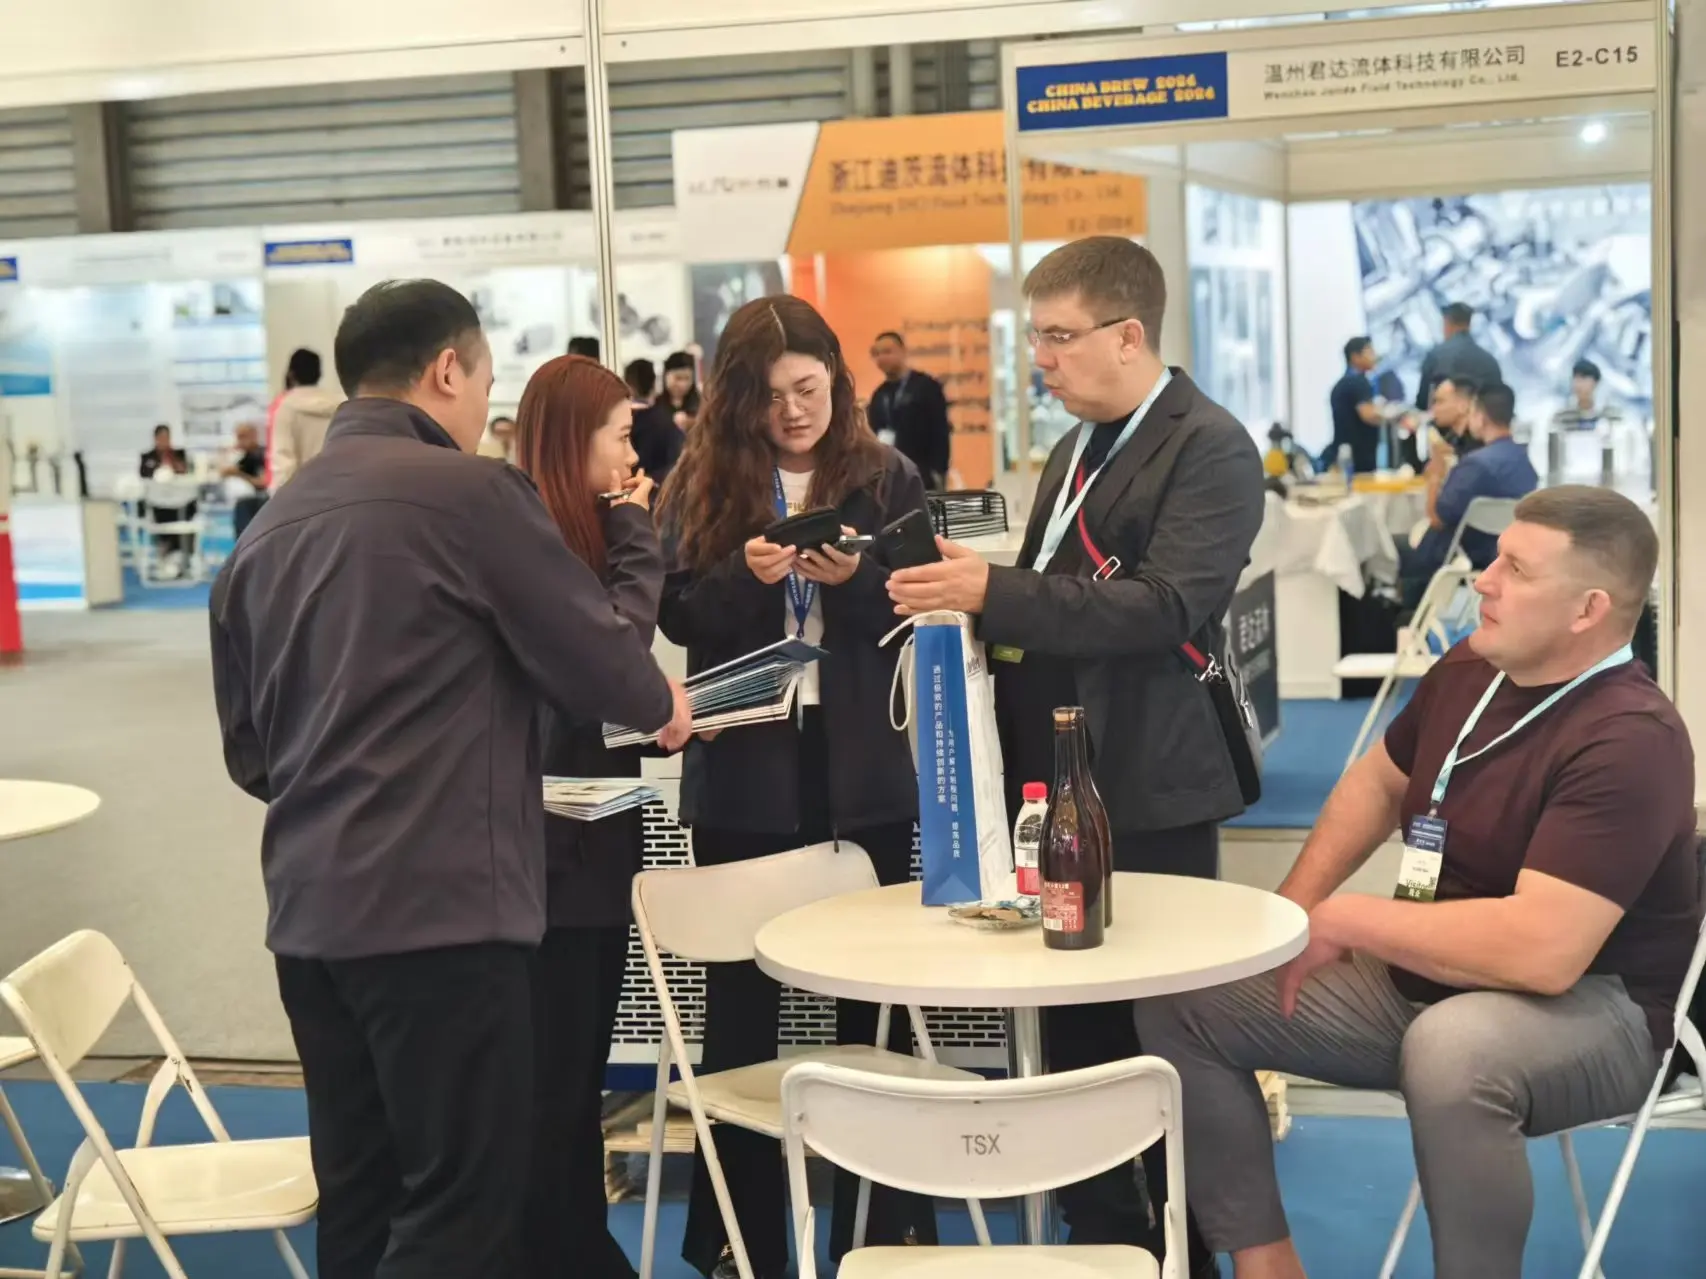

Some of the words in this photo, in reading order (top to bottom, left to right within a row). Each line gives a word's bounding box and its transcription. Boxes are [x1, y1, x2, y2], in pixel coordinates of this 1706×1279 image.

[1264, 44, 1526, 84] 温州君达流体科技有限公司
[1556, 46, 1639, 68] E2-C15
[1045, 81, 1098, 98] CHINA
[1100, 78, 1149, 95] BREW
[1156, 74, 1197, 90] 2024
[1027, 97, 1080, 113] CHINA
[1081, 90, 1168, 110] BEVERAGE
[1174, 86, 1216, 102] 2024
[961, 1133, 1001, 1156] TSX
